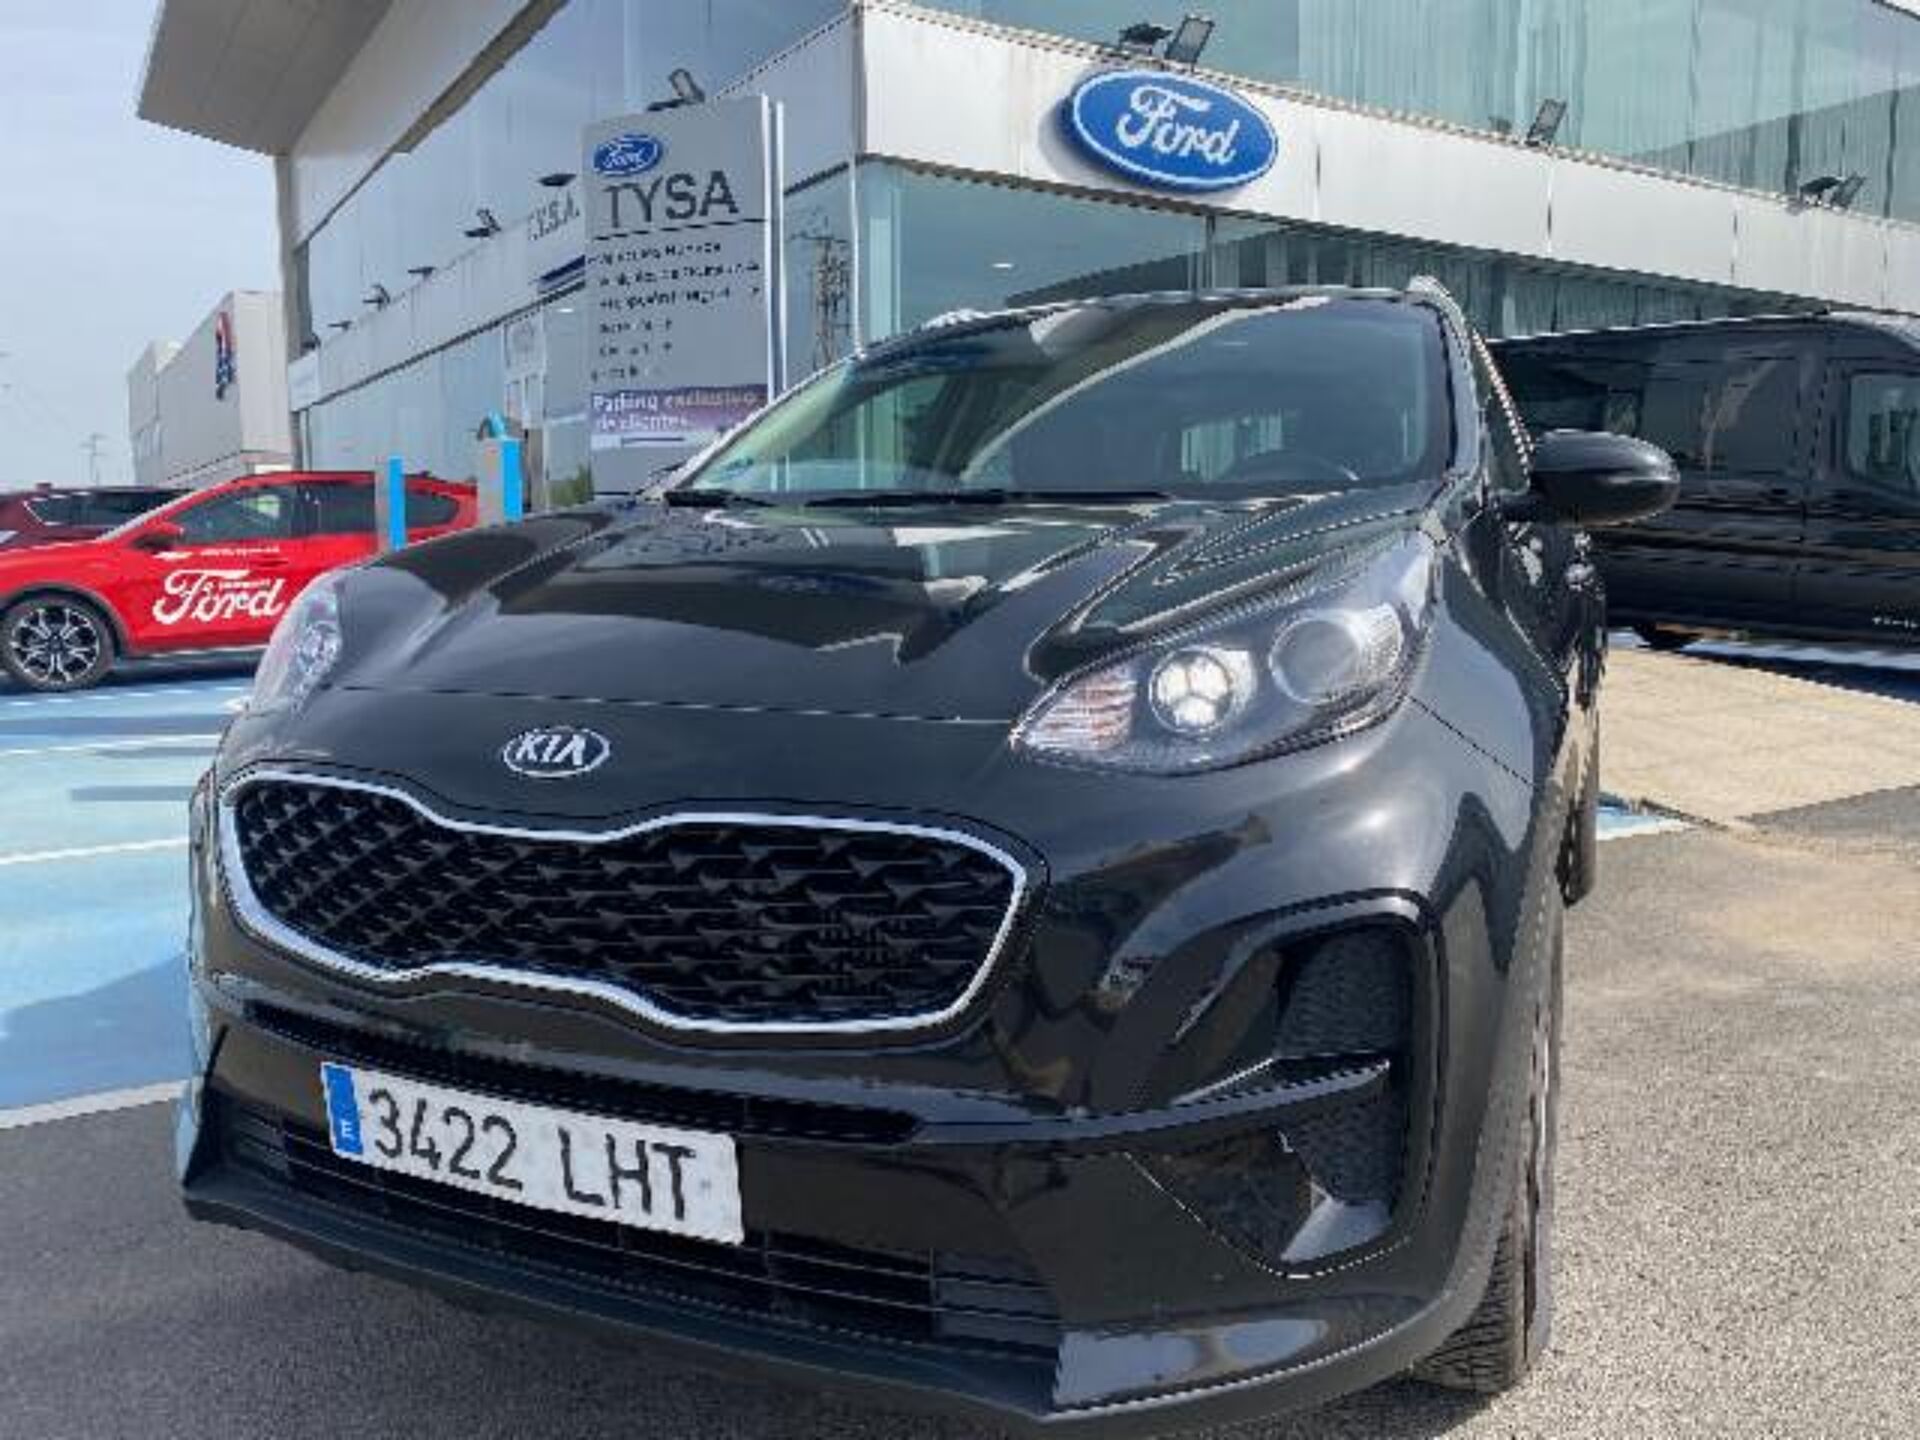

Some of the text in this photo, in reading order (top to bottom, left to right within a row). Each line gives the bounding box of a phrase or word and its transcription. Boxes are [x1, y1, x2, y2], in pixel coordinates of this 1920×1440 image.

[1115, 85, 1241, 166] Ford
[603, 140, 648, 169] Ford
[603, 170, 740, 229] TYSA
[152, 569, 286, 625] Ford
[515, 732, 586, 766] KIA
[341, 1087, 697, 1221] E 3422 LHT
